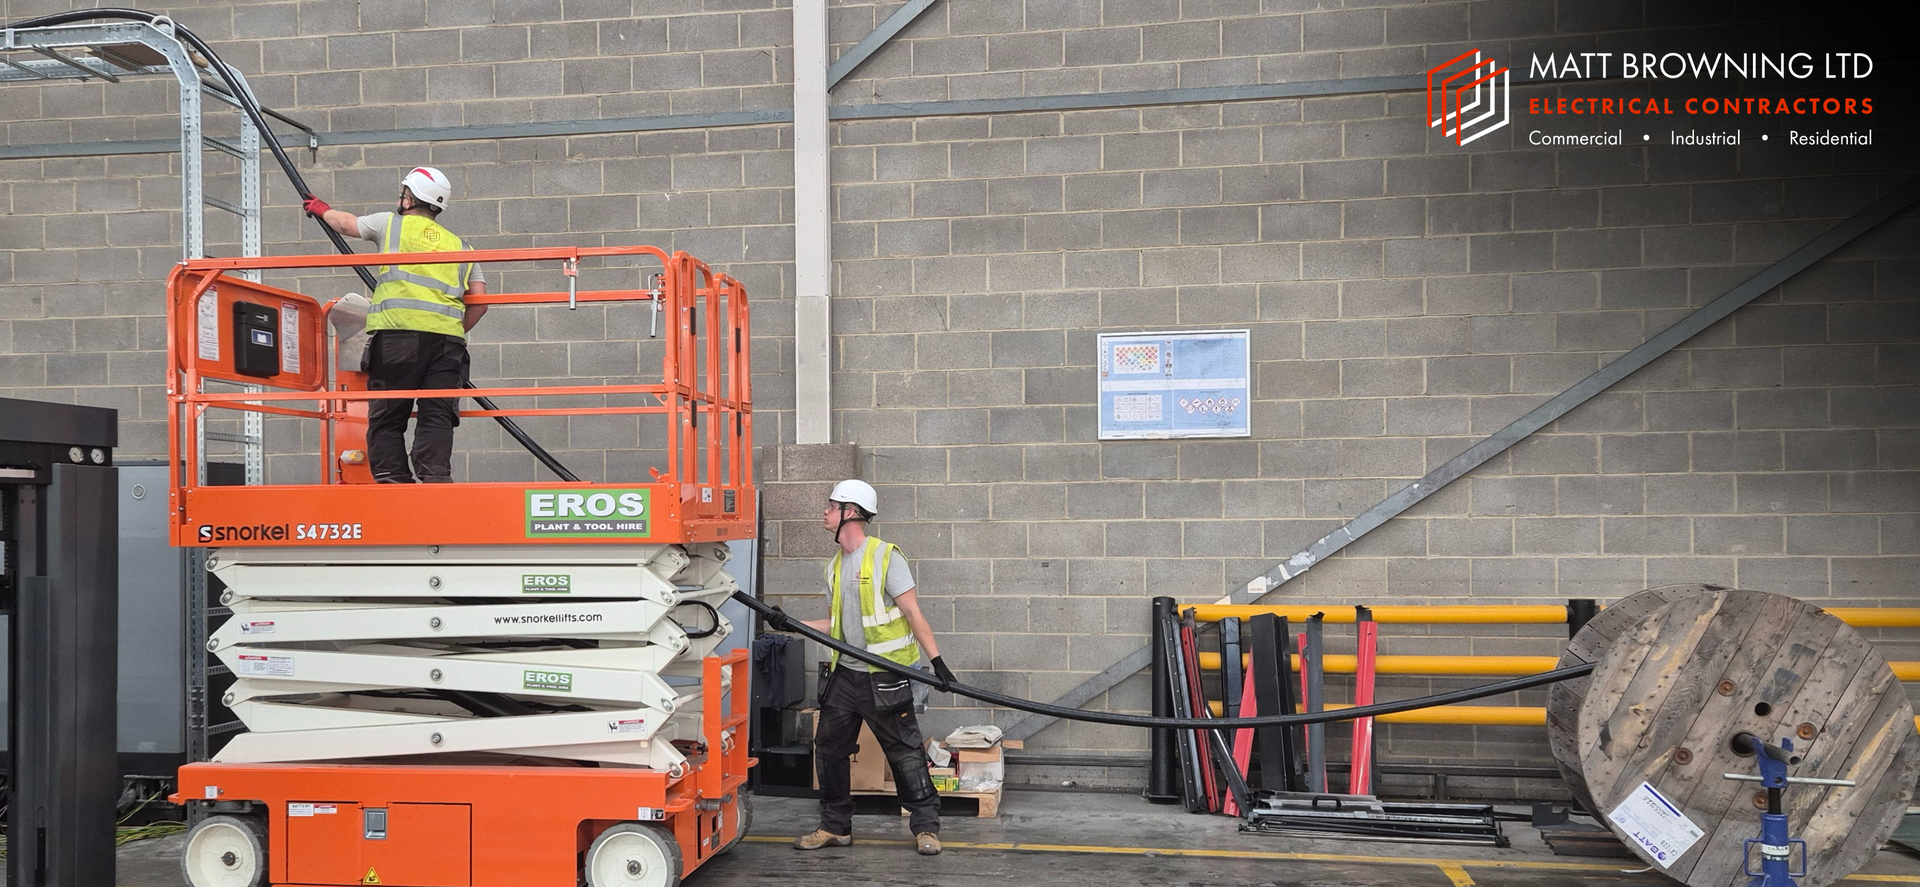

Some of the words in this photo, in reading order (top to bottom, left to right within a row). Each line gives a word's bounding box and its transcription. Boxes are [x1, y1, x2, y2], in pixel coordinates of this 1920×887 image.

[530, 493, 645, 517] EROS
[215, 524, 289, 540] snorkel
[296, 524, 362, 539] S4732E
[524, 576, 568, 585] EROS
[494, 613, 602, 624] www.snorkellifts.com
[526, 672, 570, 684] EROS
[1633, 831, 1660, 854] BATT
